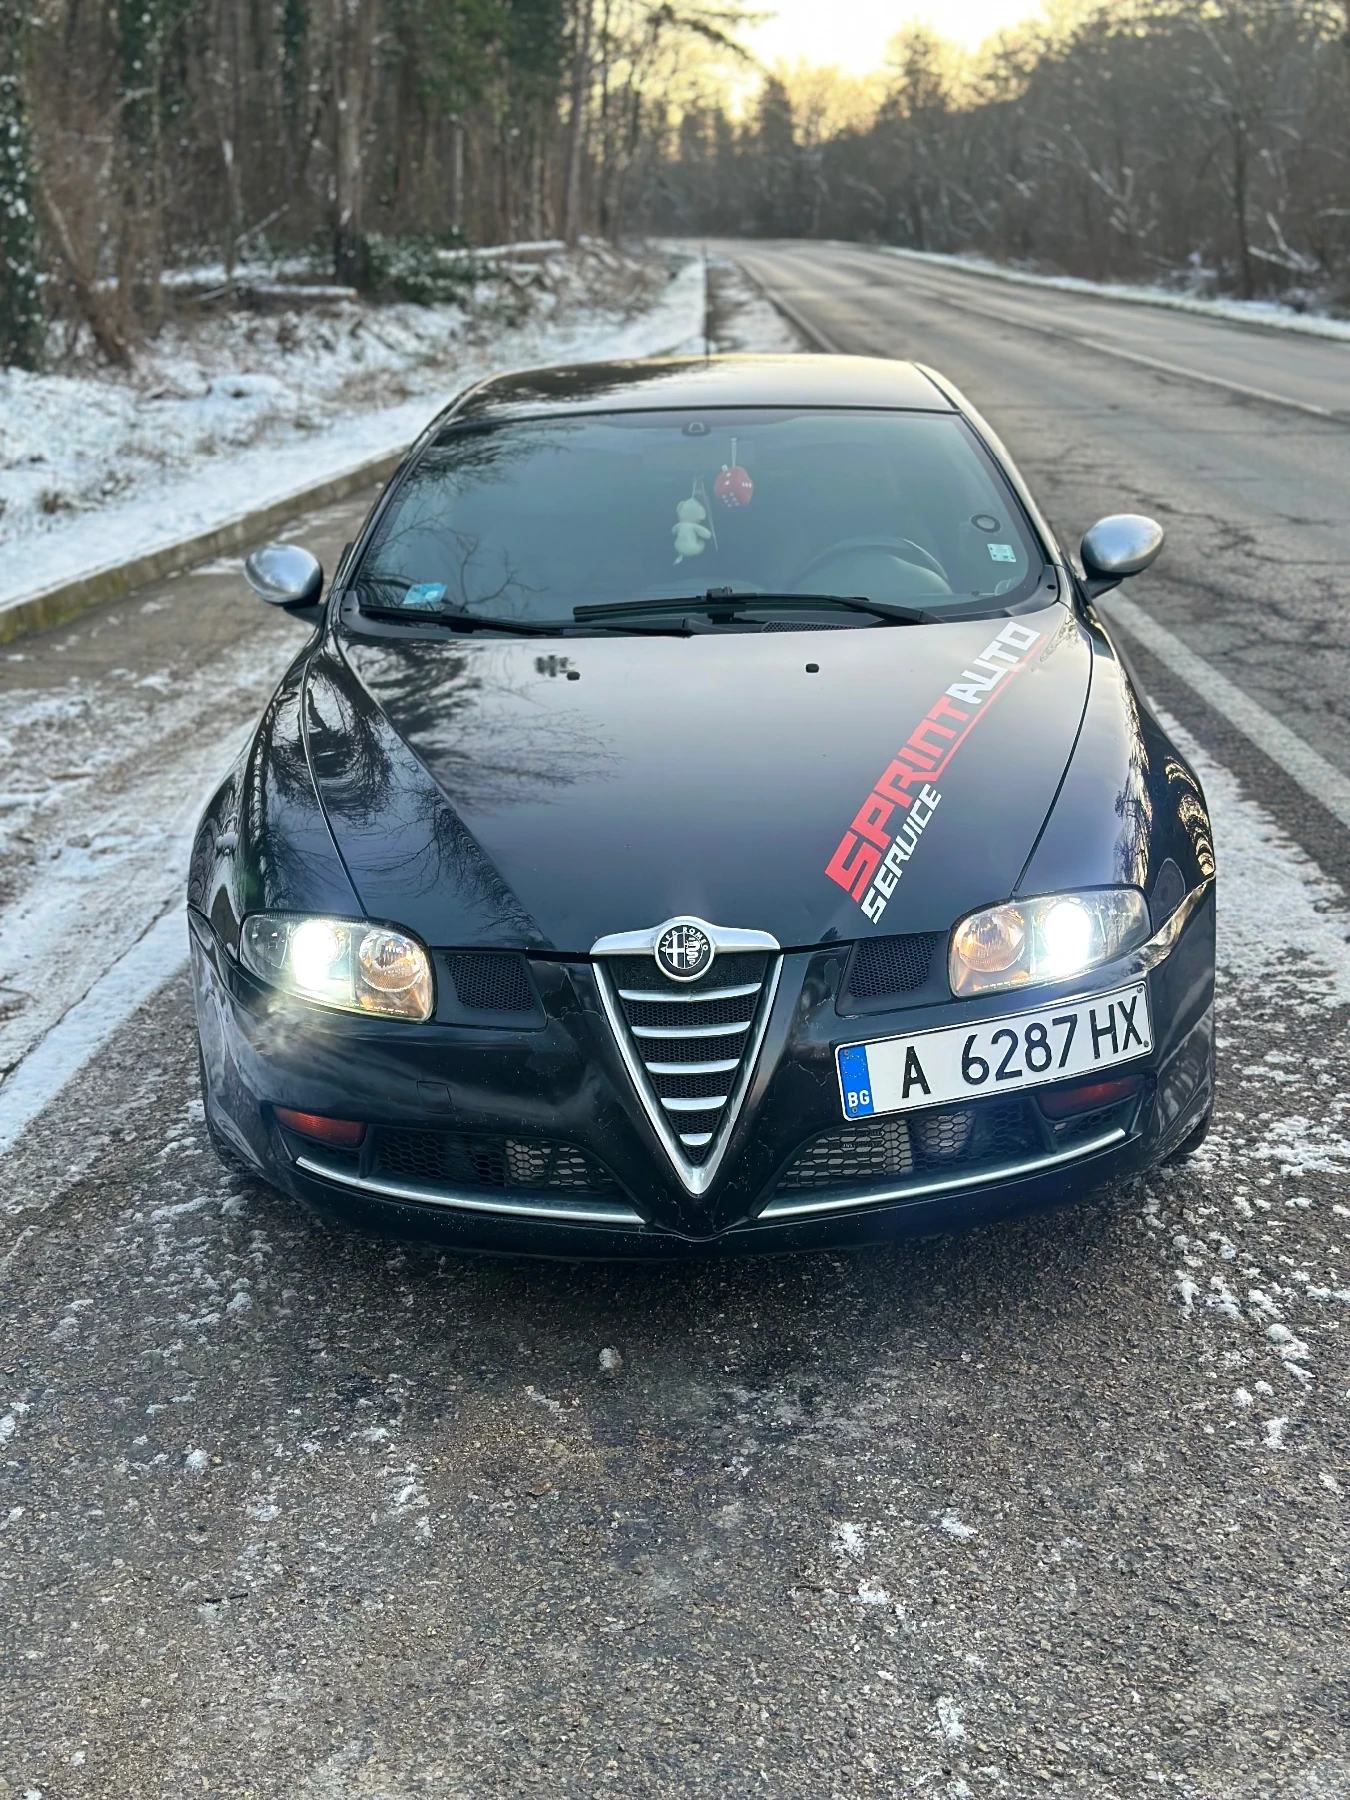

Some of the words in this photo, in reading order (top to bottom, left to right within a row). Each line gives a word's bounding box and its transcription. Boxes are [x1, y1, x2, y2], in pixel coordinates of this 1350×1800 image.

[824, 696, 970, 903] SPRINT
[945, 621, 1041, 704] AUTO
[860, 783, 942, 924] SERVICE
[682, 926, 709, 951] ROMEO
[847, 1089, 870, 1108] BG
[901, 1046, 931, 1099] A
[961, 1013, 1078, 1085] 6287
[1089, 995, 1143, 1060] HX
